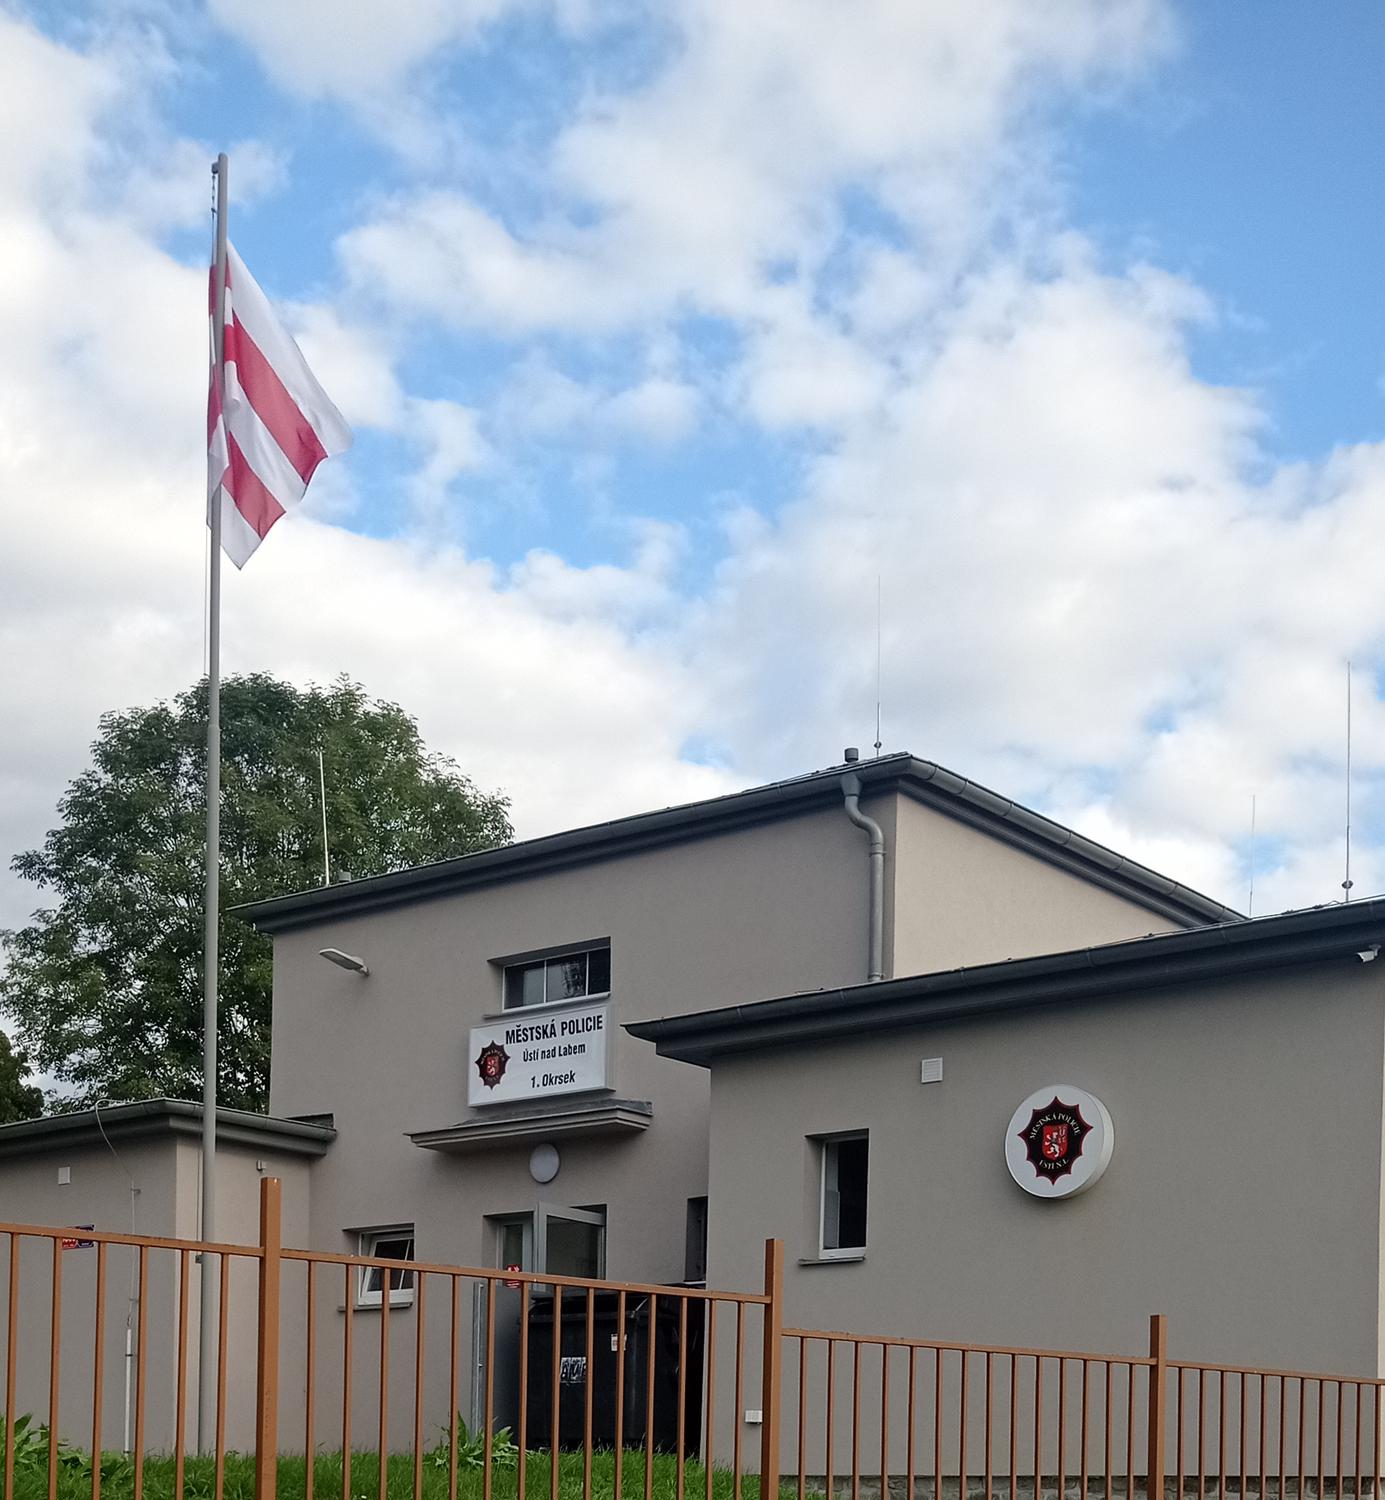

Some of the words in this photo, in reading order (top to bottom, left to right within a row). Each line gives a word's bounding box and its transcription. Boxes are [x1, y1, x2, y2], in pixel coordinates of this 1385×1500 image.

[505, 1019, 557, 1044] MĚSTSKÁ
[561, 1015, 603, 1036] POLICIE
[523, 1048, 539, 1062] Ústí
[541, 1046, 556, 1060] nad
[558, 1043, 586, 1057] Labem
[530, 1076, 540, 1088] 1.
[542, 1070, 576, 1087] Okrsek
